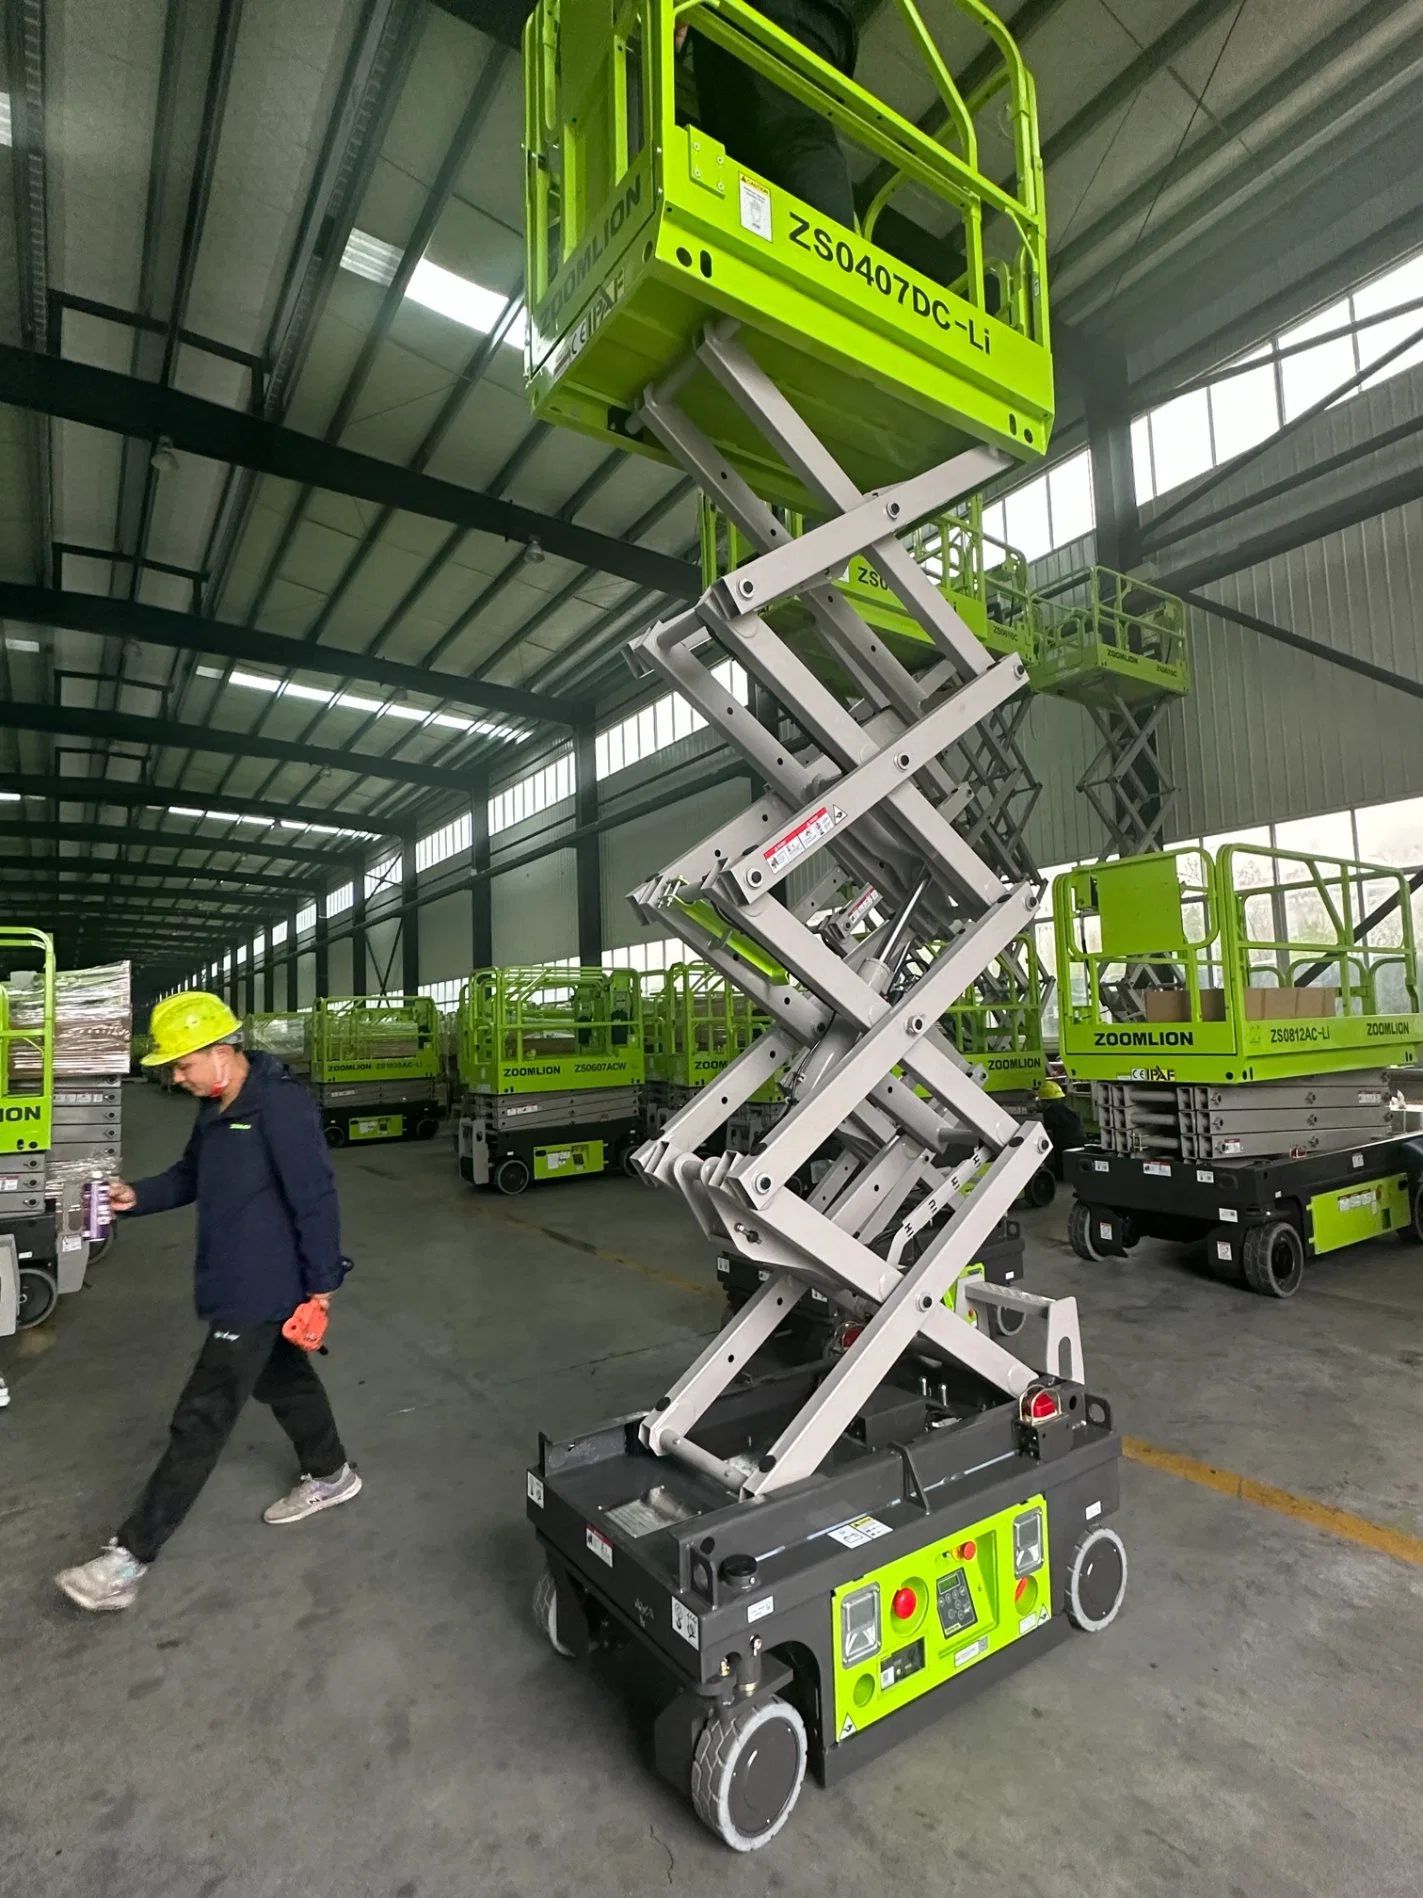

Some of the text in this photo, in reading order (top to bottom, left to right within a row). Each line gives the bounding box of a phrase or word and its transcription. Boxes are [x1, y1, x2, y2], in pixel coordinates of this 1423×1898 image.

[540, 174, 641, 338] ZOOMLION
[788, 211, 991, 355] ZS0407DC-Li
[1107, 648, 1139, 665] ZOOMLION
[1366, 1021, 1410, 1036] ZOOMLION
[1094, 1031, 1194, 1046] ZOOMLION
[327, 1063, 371, 1072] ZOOMLION
[504, 1065, 561, 1077] ZOOMLION
[988, 1057, 1041, 1071] ZOOMLION
[1146, 1066, 1176, 1081] IPAF
